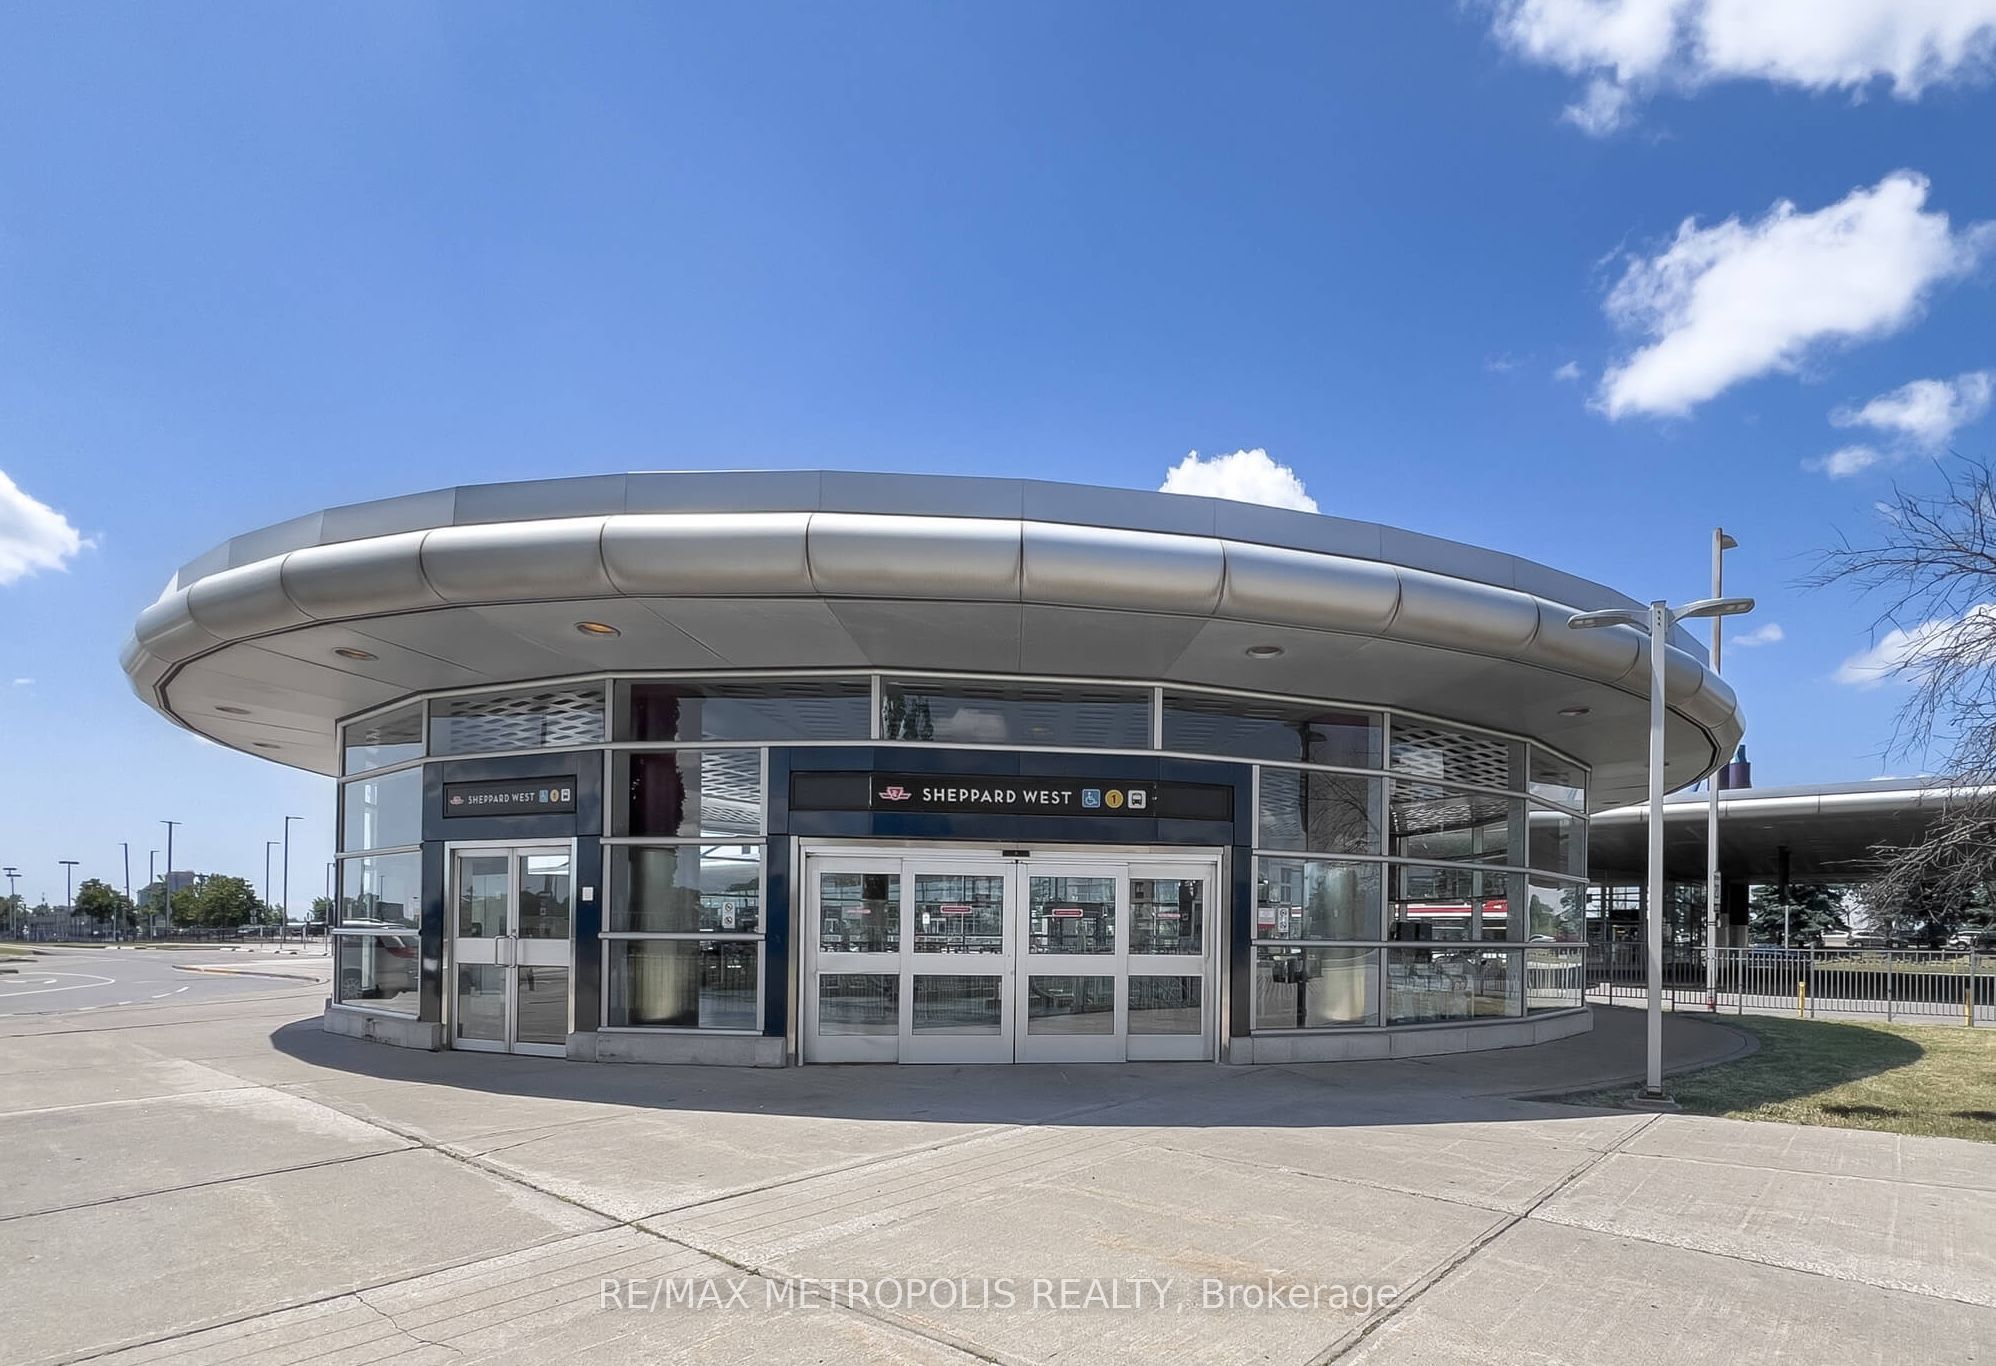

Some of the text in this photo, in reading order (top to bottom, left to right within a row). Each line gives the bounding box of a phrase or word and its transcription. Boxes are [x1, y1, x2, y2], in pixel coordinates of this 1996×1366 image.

[468, 793, 510, 805] SHEPPARD
[511, 792, 535, 802] WEST
[923, 788, 1016, 803] SHEPPARD
[1023, 790, 1072, 805] WEST
